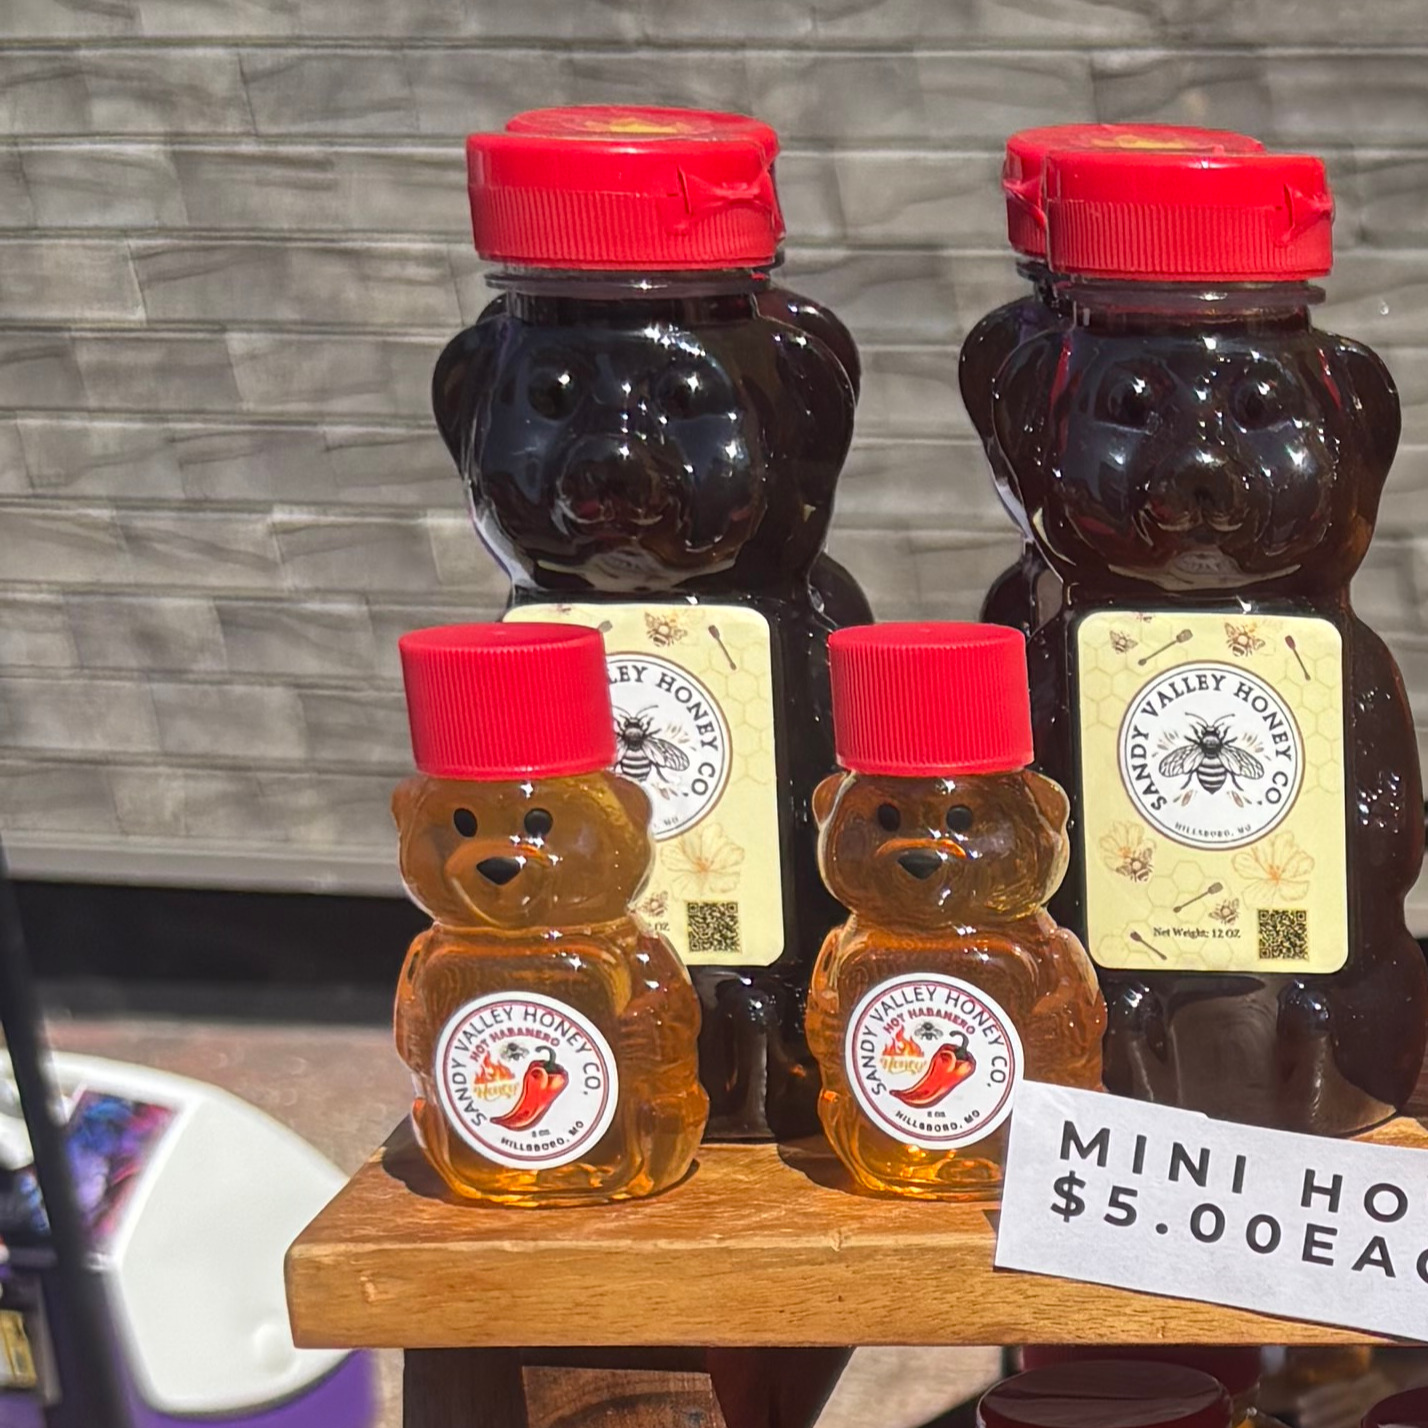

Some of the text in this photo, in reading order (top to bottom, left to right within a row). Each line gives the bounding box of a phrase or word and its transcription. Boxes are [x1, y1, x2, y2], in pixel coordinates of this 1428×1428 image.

[655, 671, 719, 752] HONEY
[1141, 673, 1227, 718] VALLEY
[1233, 683, 1293, 762] HONEY
[1130, 725, 1168, 811] SANDY
[1153, 926, 1170, 938] Net
[1211, 928, 1224, 938] 12
[1225, 928, 1241, 939] OZ
[454, 1007, 513, 1051] VALLEY
[523, 1008, 592, 1054] HONEY
[869, 986, 937, 1023] VALLEY
[944, 991, 1005, 1046] HONEY
[860, 1025, 887, 1096] SANDY
[452, 1058, 487, 1127] SANDY
[1058, 1119, 1248, 1195] MINI
